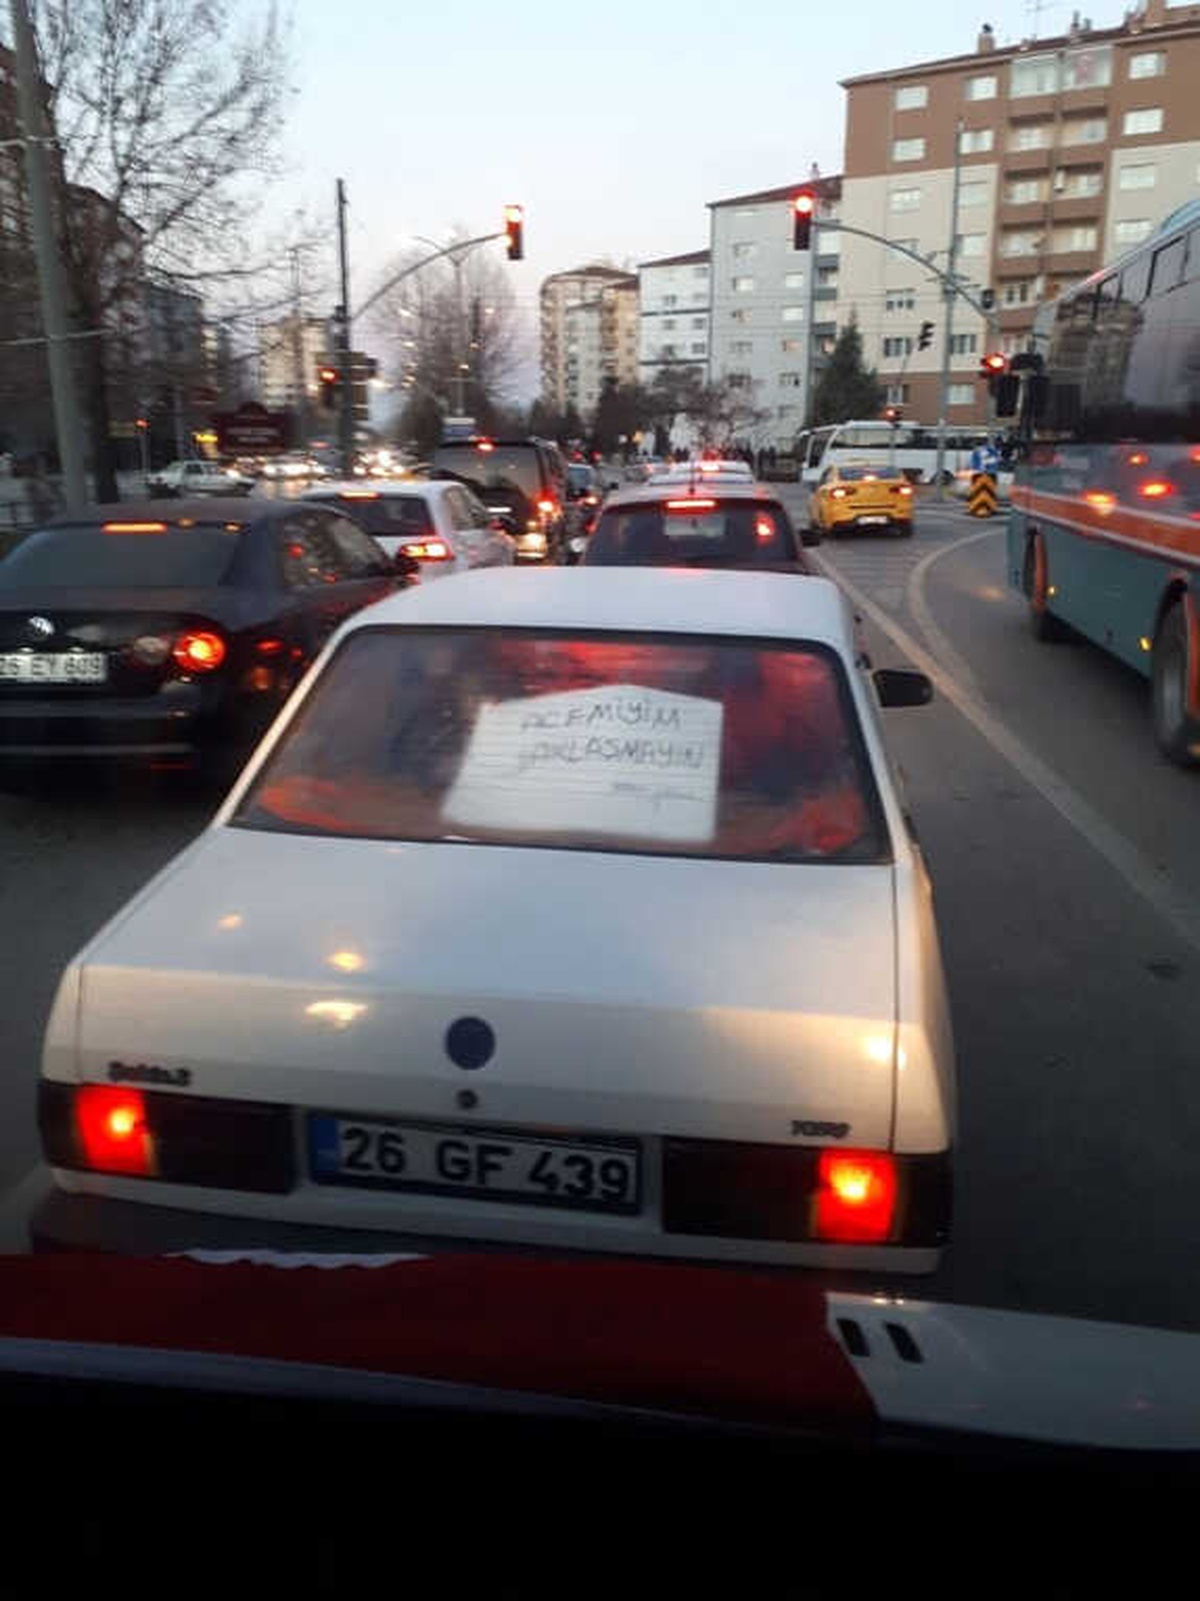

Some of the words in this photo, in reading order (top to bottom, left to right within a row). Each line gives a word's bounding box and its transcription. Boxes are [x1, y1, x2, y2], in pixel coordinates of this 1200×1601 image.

[342, 1127, 406, 1174] 26
[436, 1140, 514, 1185] GF
[529, 1150, 629, 1200] 439
